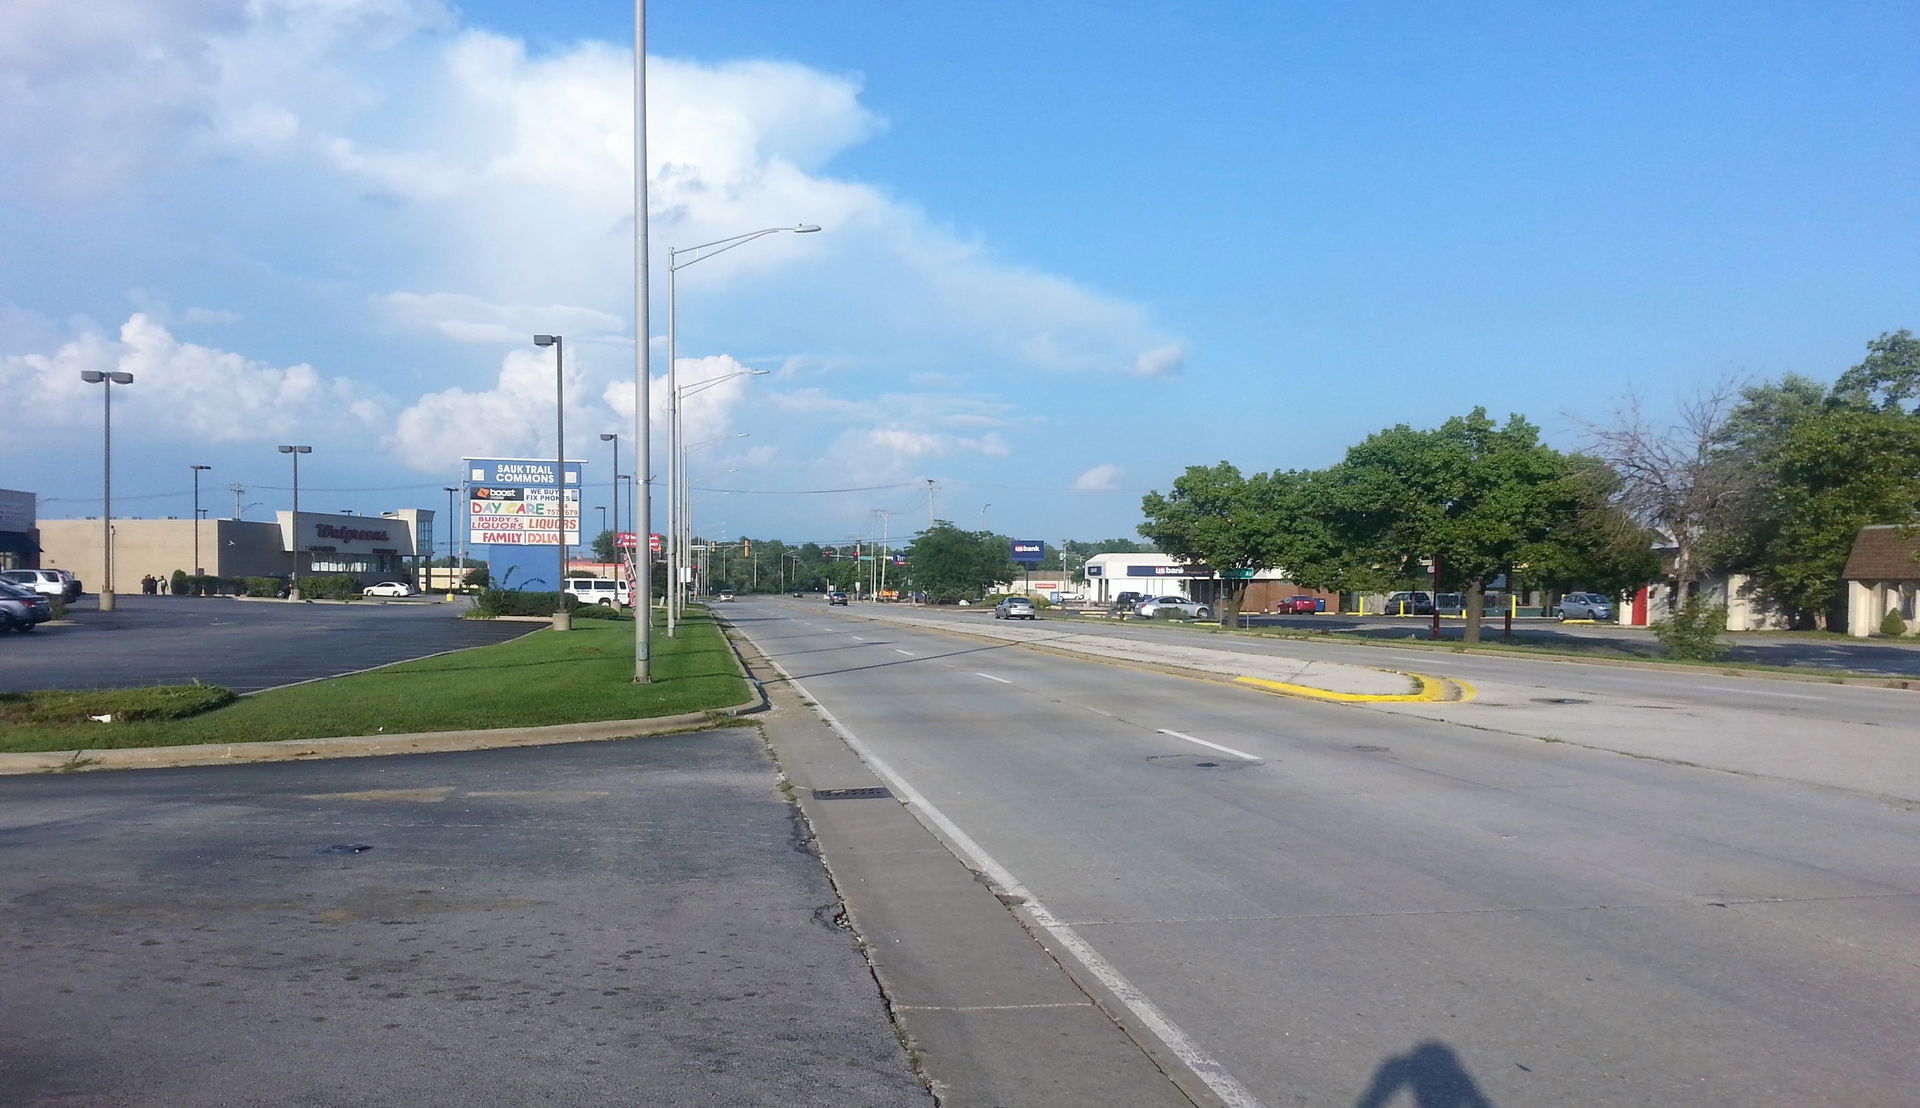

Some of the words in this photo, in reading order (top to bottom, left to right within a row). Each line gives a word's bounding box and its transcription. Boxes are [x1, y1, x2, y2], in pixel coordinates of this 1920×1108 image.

[497, 465, 523, 474] SAUK
[525, 465, 552, 474] TRAIL
[496, 474, 554, 483] COMMONS
[472, 502, 502, 514] DAY
[505, 503, 545, 515] CARE
[483, 532, 523, 543] FAMILY
[528, 533, 566, 543] DOLLA
